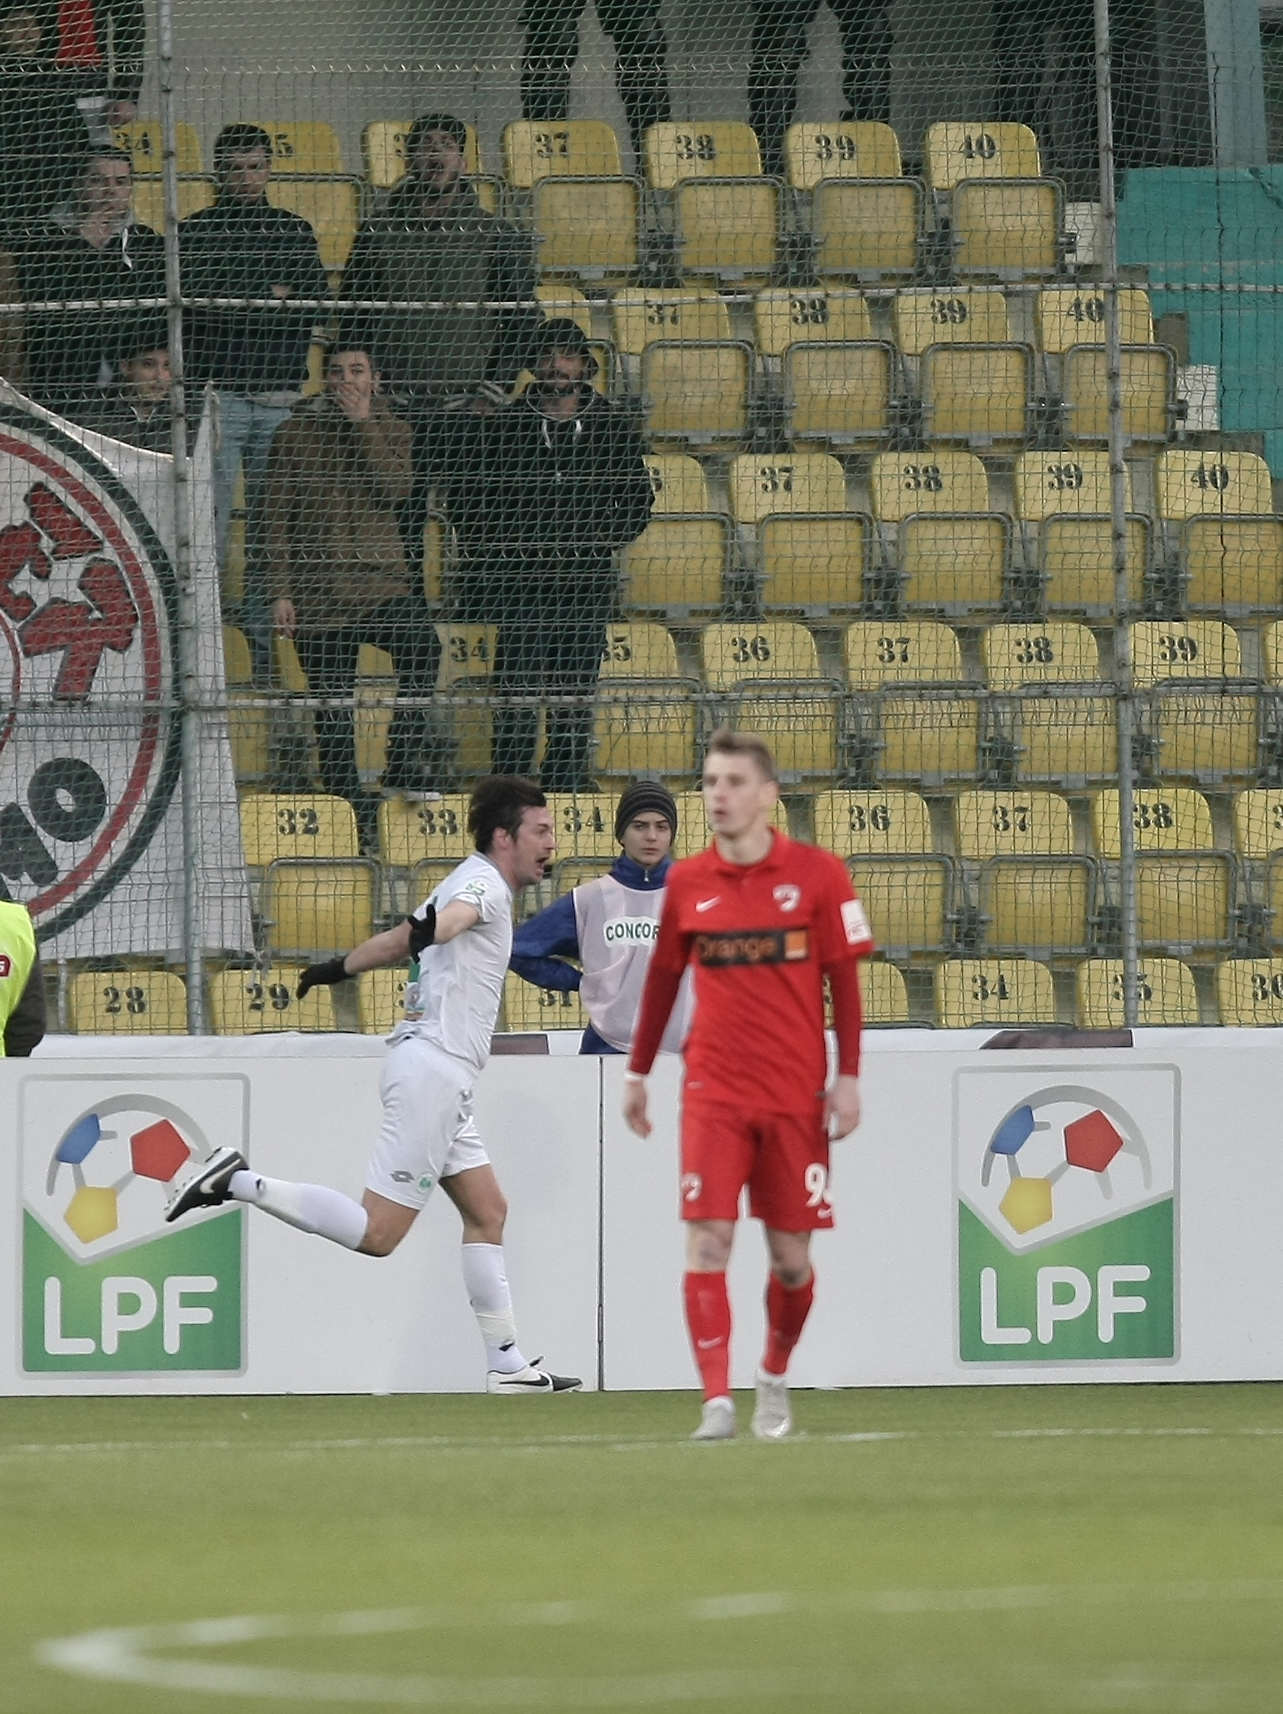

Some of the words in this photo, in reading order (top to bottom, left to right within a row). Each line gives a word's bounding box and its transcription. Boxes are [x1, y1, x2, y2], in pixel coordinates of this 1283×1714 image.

[535, 132, 570, 159] 37
[675, 132, 716, 161] 38
[814, 133, 857, 162] 39
[961, 132, 997, 160] 40
[790, 299, 828, 326] 38
[930, 299, 968, 325] 39
[1067, 297, 1105, 322] 40
[760, 466, 795, 493] 37
[904, 464, 943, 493] 38
[1047, 463, 1084, 491] 39
[1190, 463, 1230, 491] 40
[450, 637, 490, 663] 34
[602, 635, 631, 662] 5
[731, 636, 771, 663] 36
[876, 637, 911, 664] 37
[1016, 636, 1054, 664] 38
[1159, 636, 1199, 663] 39
[276, 808, 320, 836] 32
[417, 809, 458, 836] 33
[563, 806, 606, 833] 34
[848, 805, 891, 832] 36
[993, 805, 1029, 832] 37
[1132, 801, 1174, 829] 38
[696, 935, 778, 963] Orange
[103, 986, 146, 1014] 28
[246, 983, 290, 1011] 29
[972, 974, 1010, 1000] 34
[43, 1275, 219, 1355] LPF
[979, 1264, 1153, 1346] LPF
